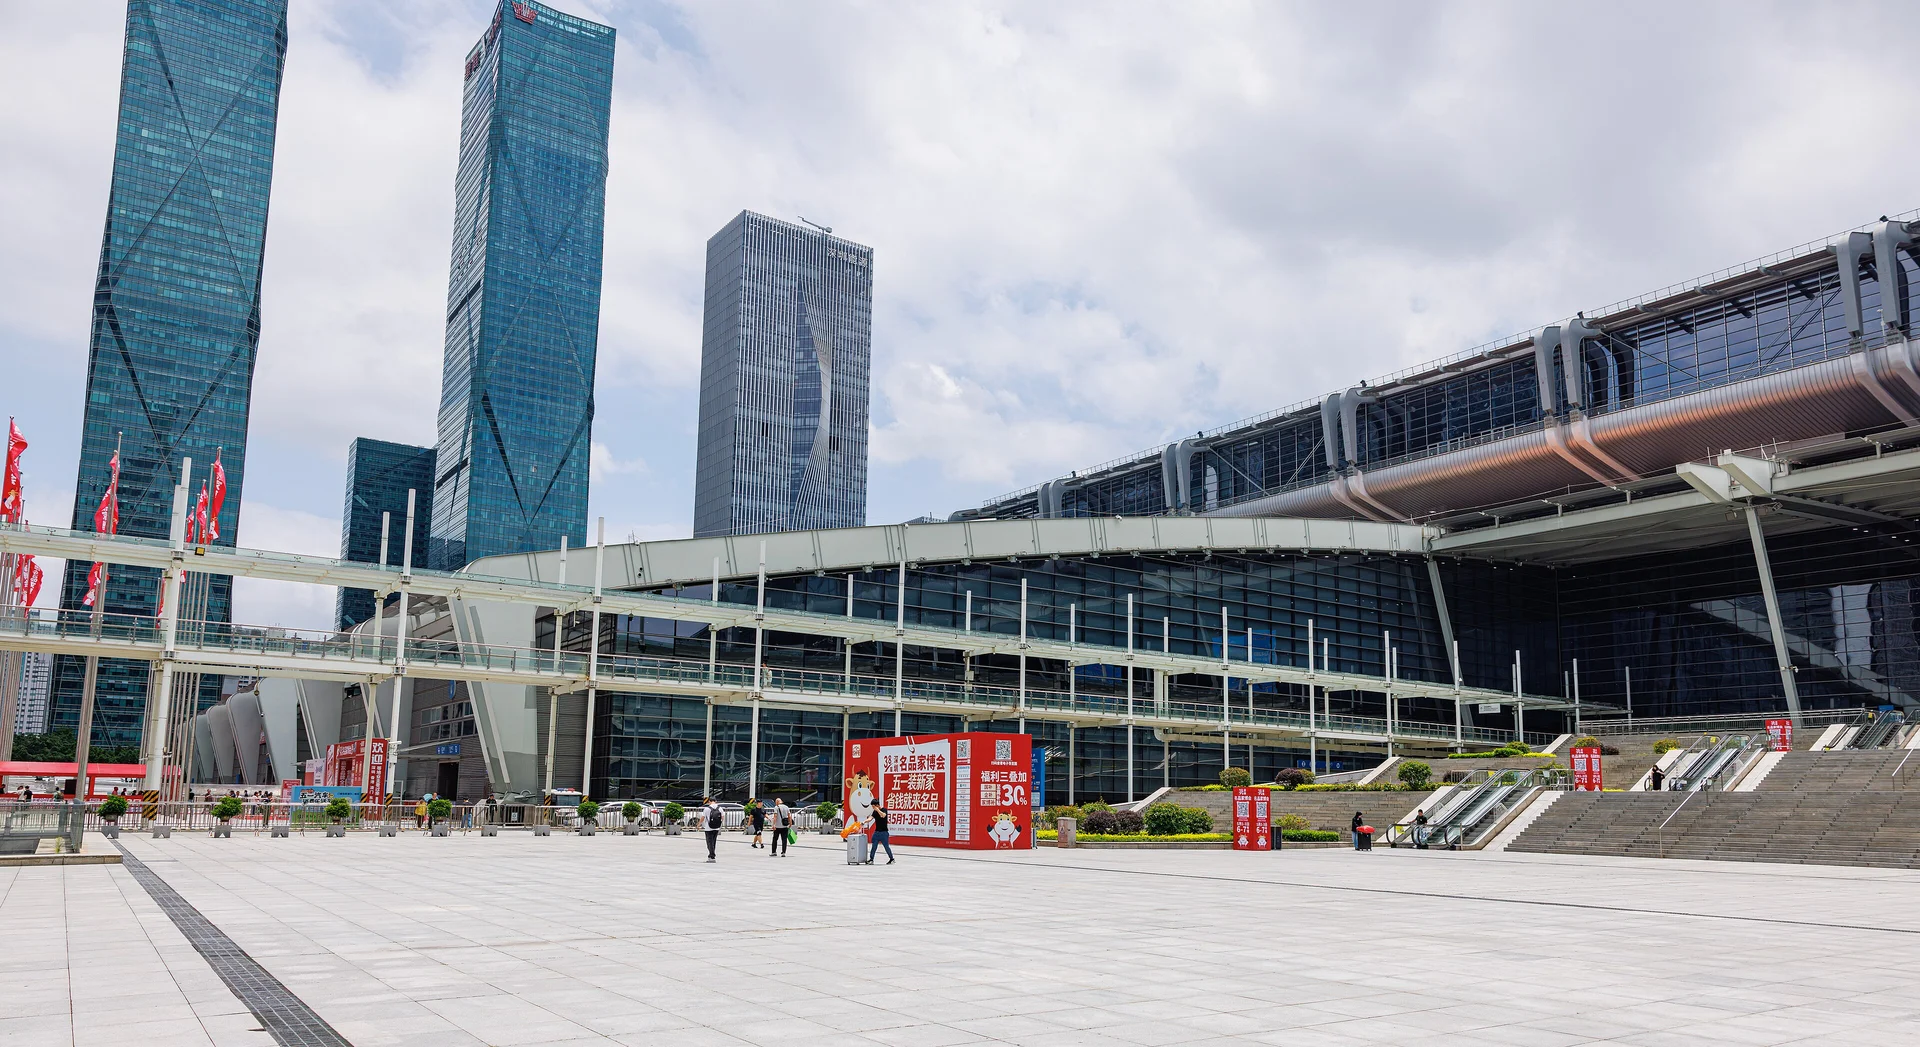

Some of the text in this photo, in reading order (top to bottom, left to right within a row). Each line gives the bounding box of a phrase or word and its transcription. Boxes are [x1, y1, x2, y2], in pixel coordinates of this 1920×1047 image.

[371, 742, 383, 765] 欢迎
[900, 754, 945, 771] 名品家博会
[892, 773, 935, 790] 五一装新家
[981, 770, 1027, 782] 福利三叠加
[886, 792, 938, 810] 省钱就来名品
[1001, 784, 1027, 806] 30%
[920, 814, 945, 827] 6/7号馆
